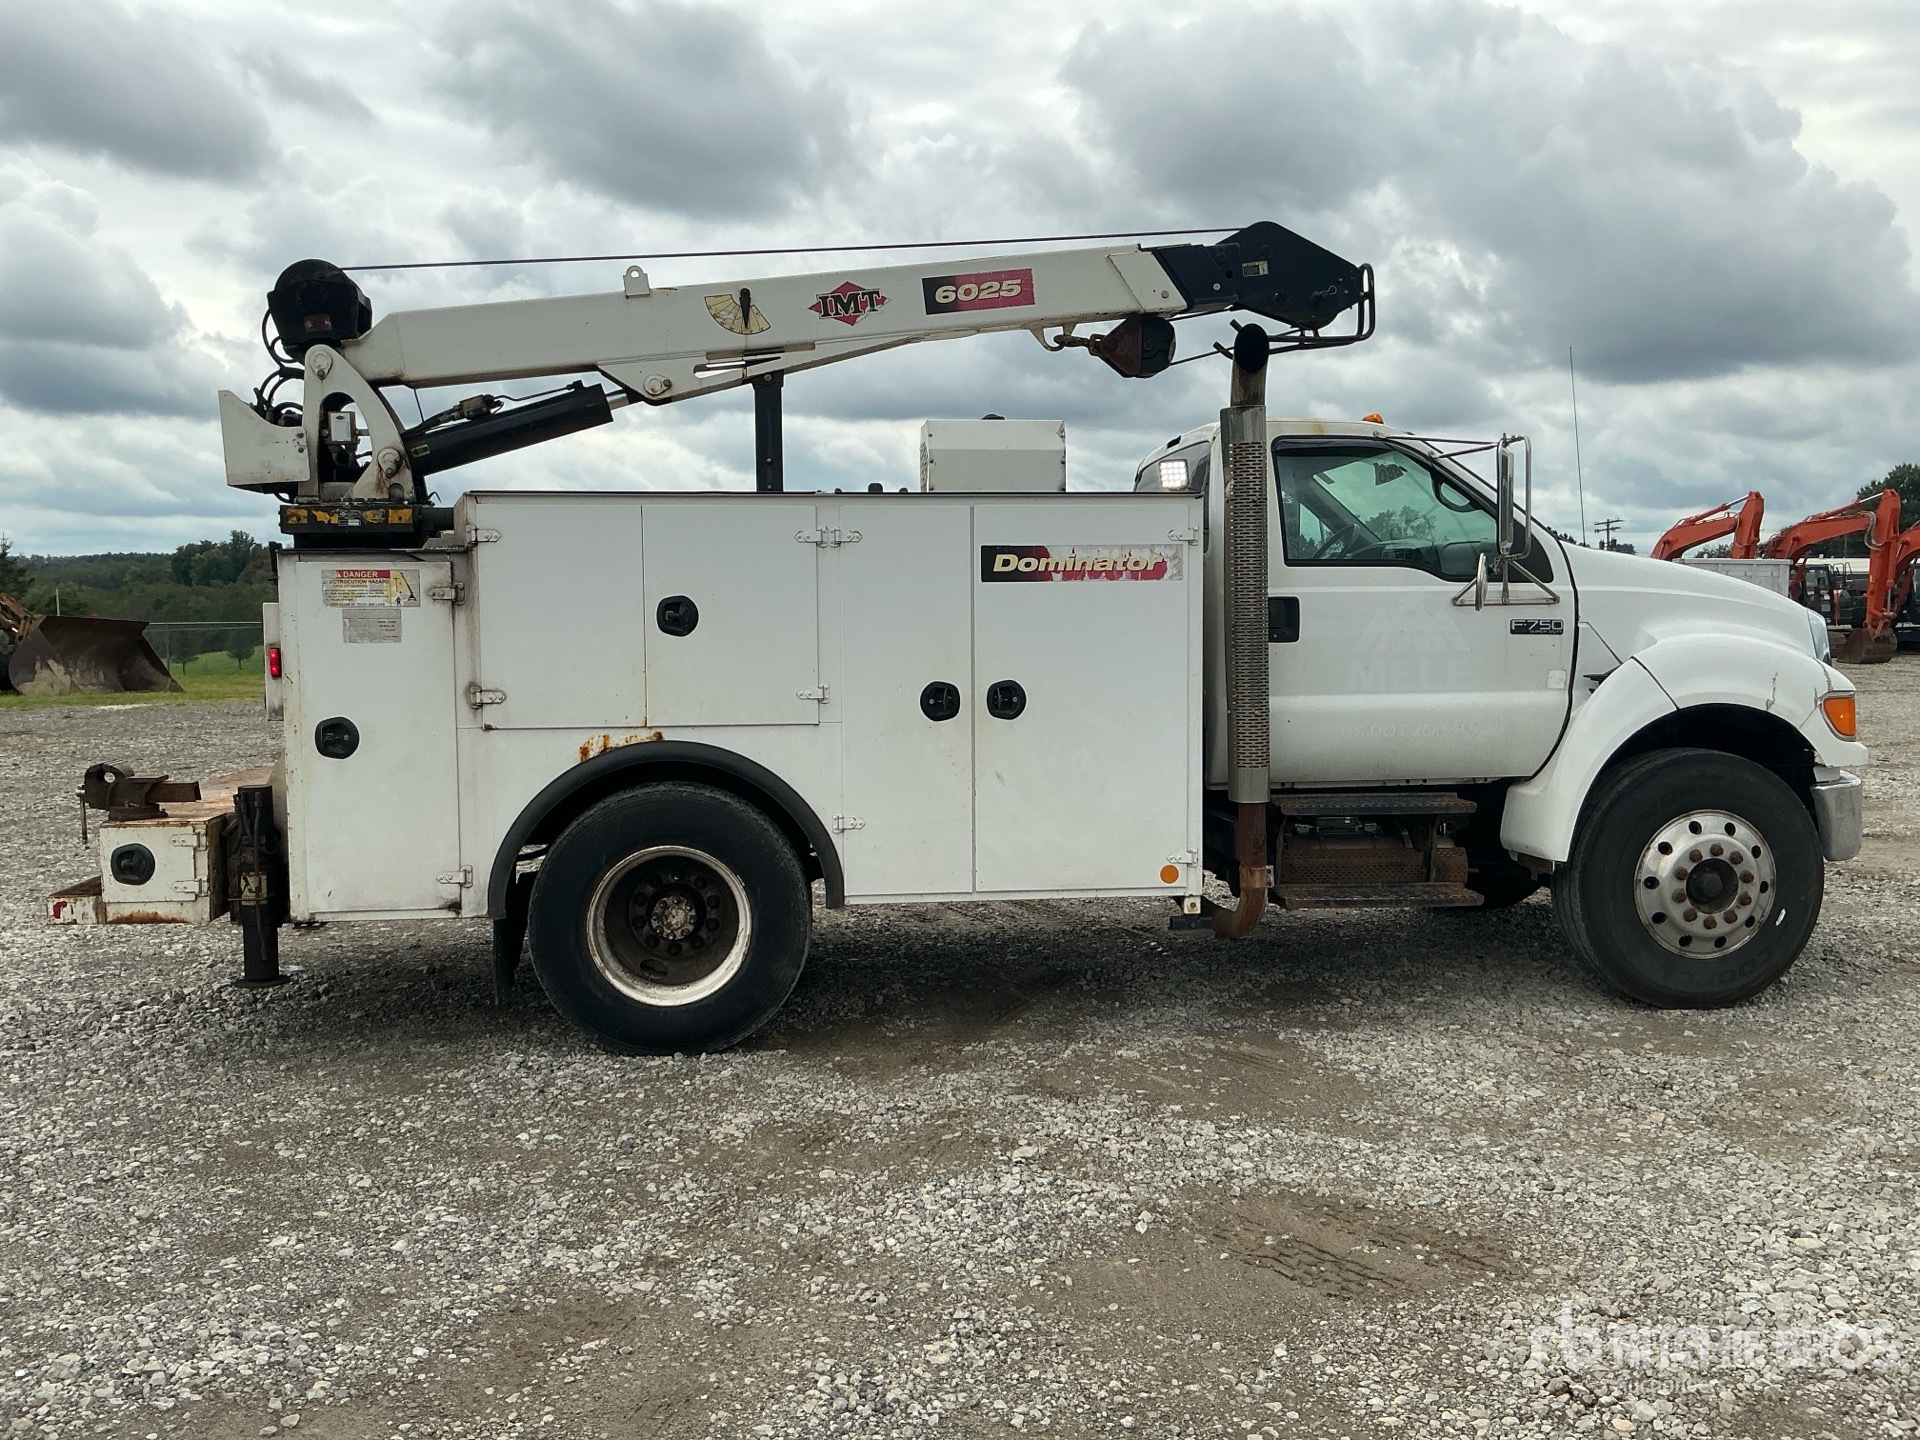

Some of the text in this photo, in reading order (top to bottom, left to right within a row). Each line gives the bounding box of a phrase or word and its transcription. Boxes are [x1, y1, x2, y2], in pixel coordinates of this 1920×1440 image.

[817, 289, 881, 318] IMT
[934, 279, 1022, 304] 6025
[992, 553, 1165, 572] Dominator
